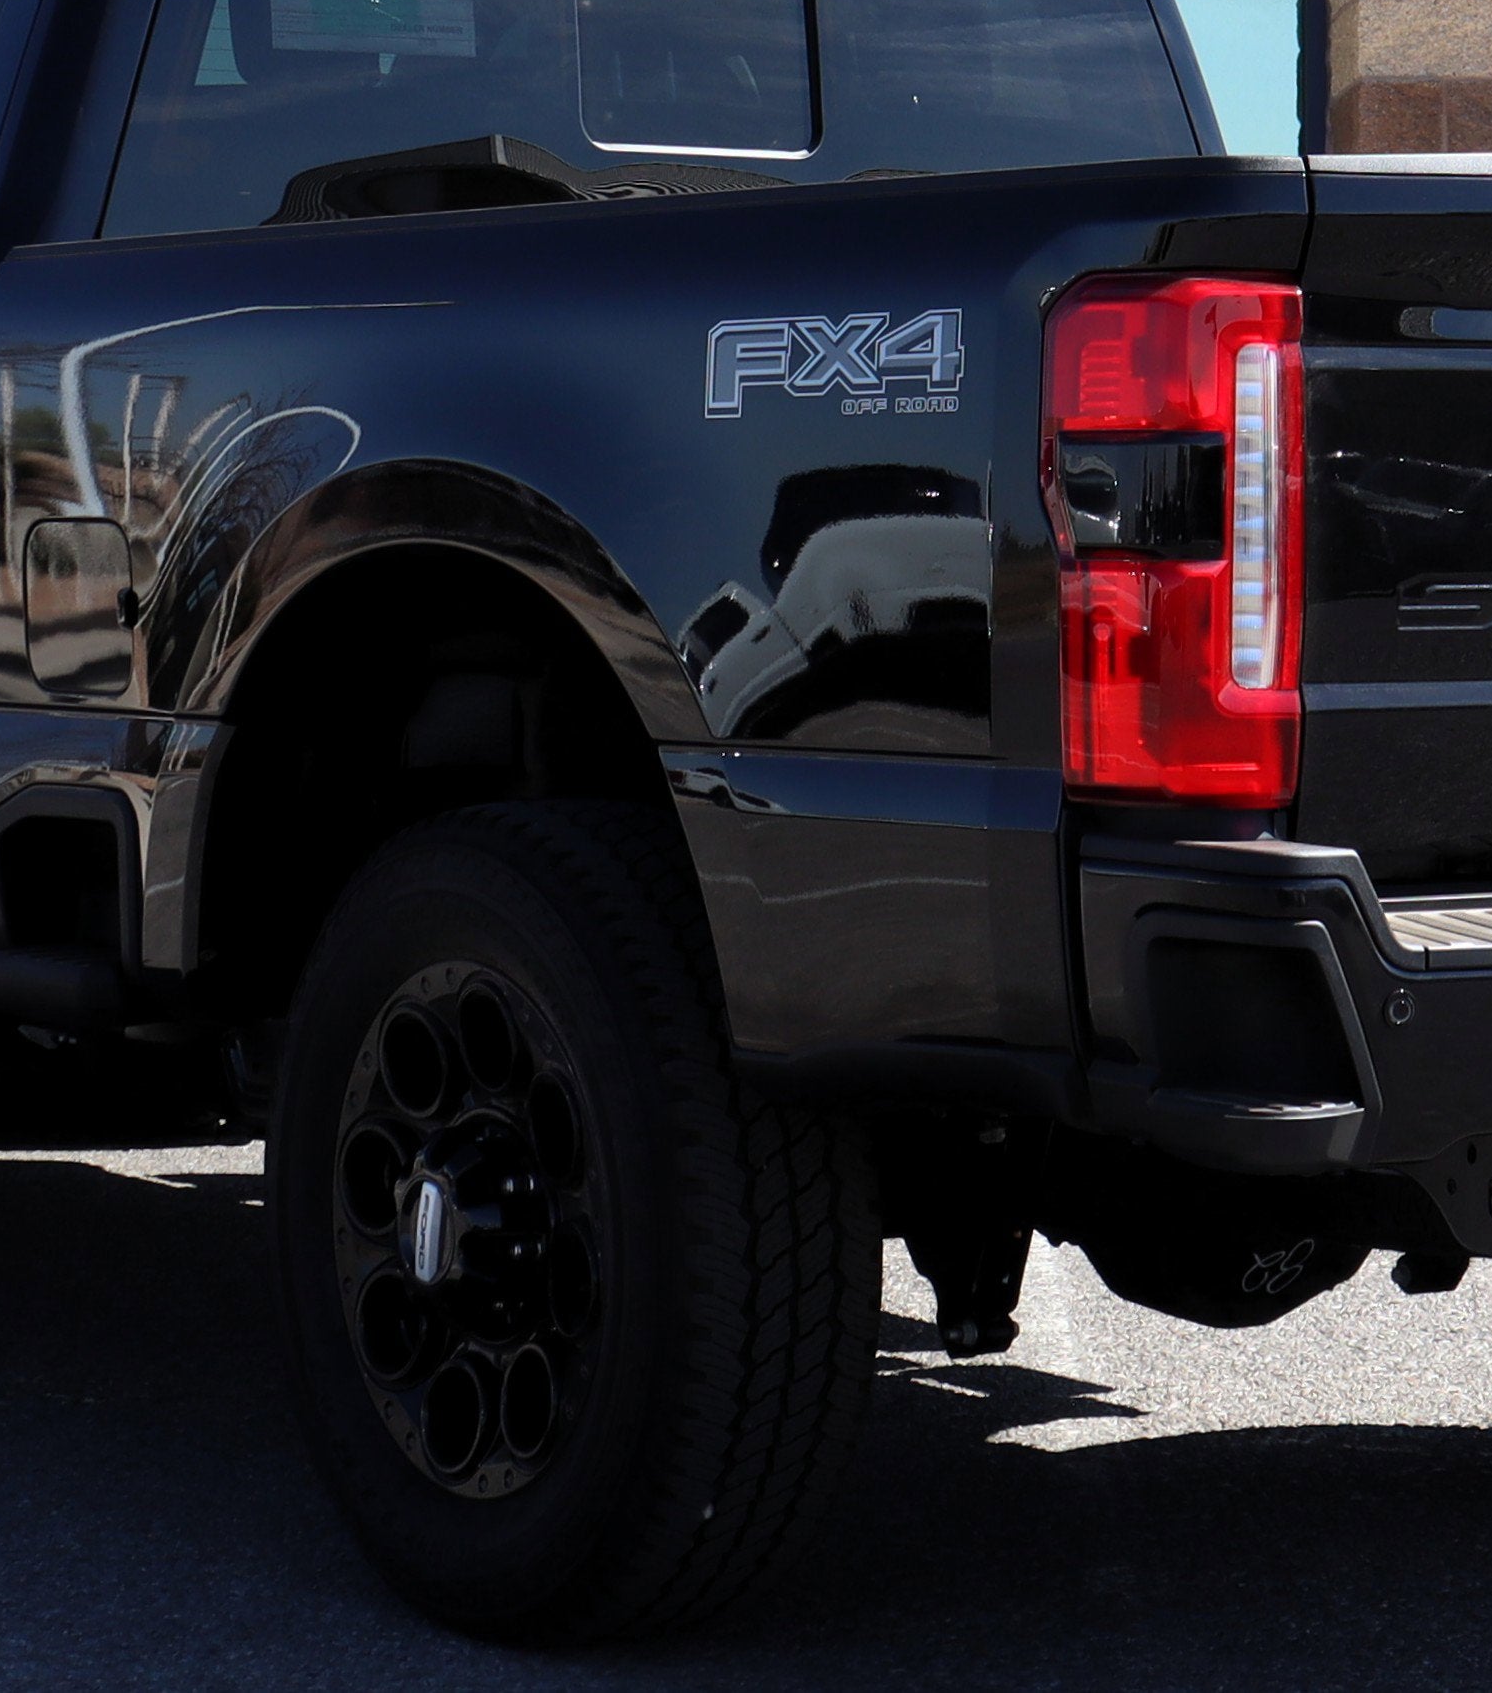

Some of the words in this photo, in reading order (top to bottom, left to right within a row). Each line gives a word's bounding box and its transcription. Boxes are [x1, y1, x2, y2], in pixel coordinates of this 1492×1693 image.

[705, 308, 964, 418] FX4
[841, 398, 887, 415] OFF
[895, 396, 959, 414] ROAD
[418, 1193, 430, 1270] FORD
